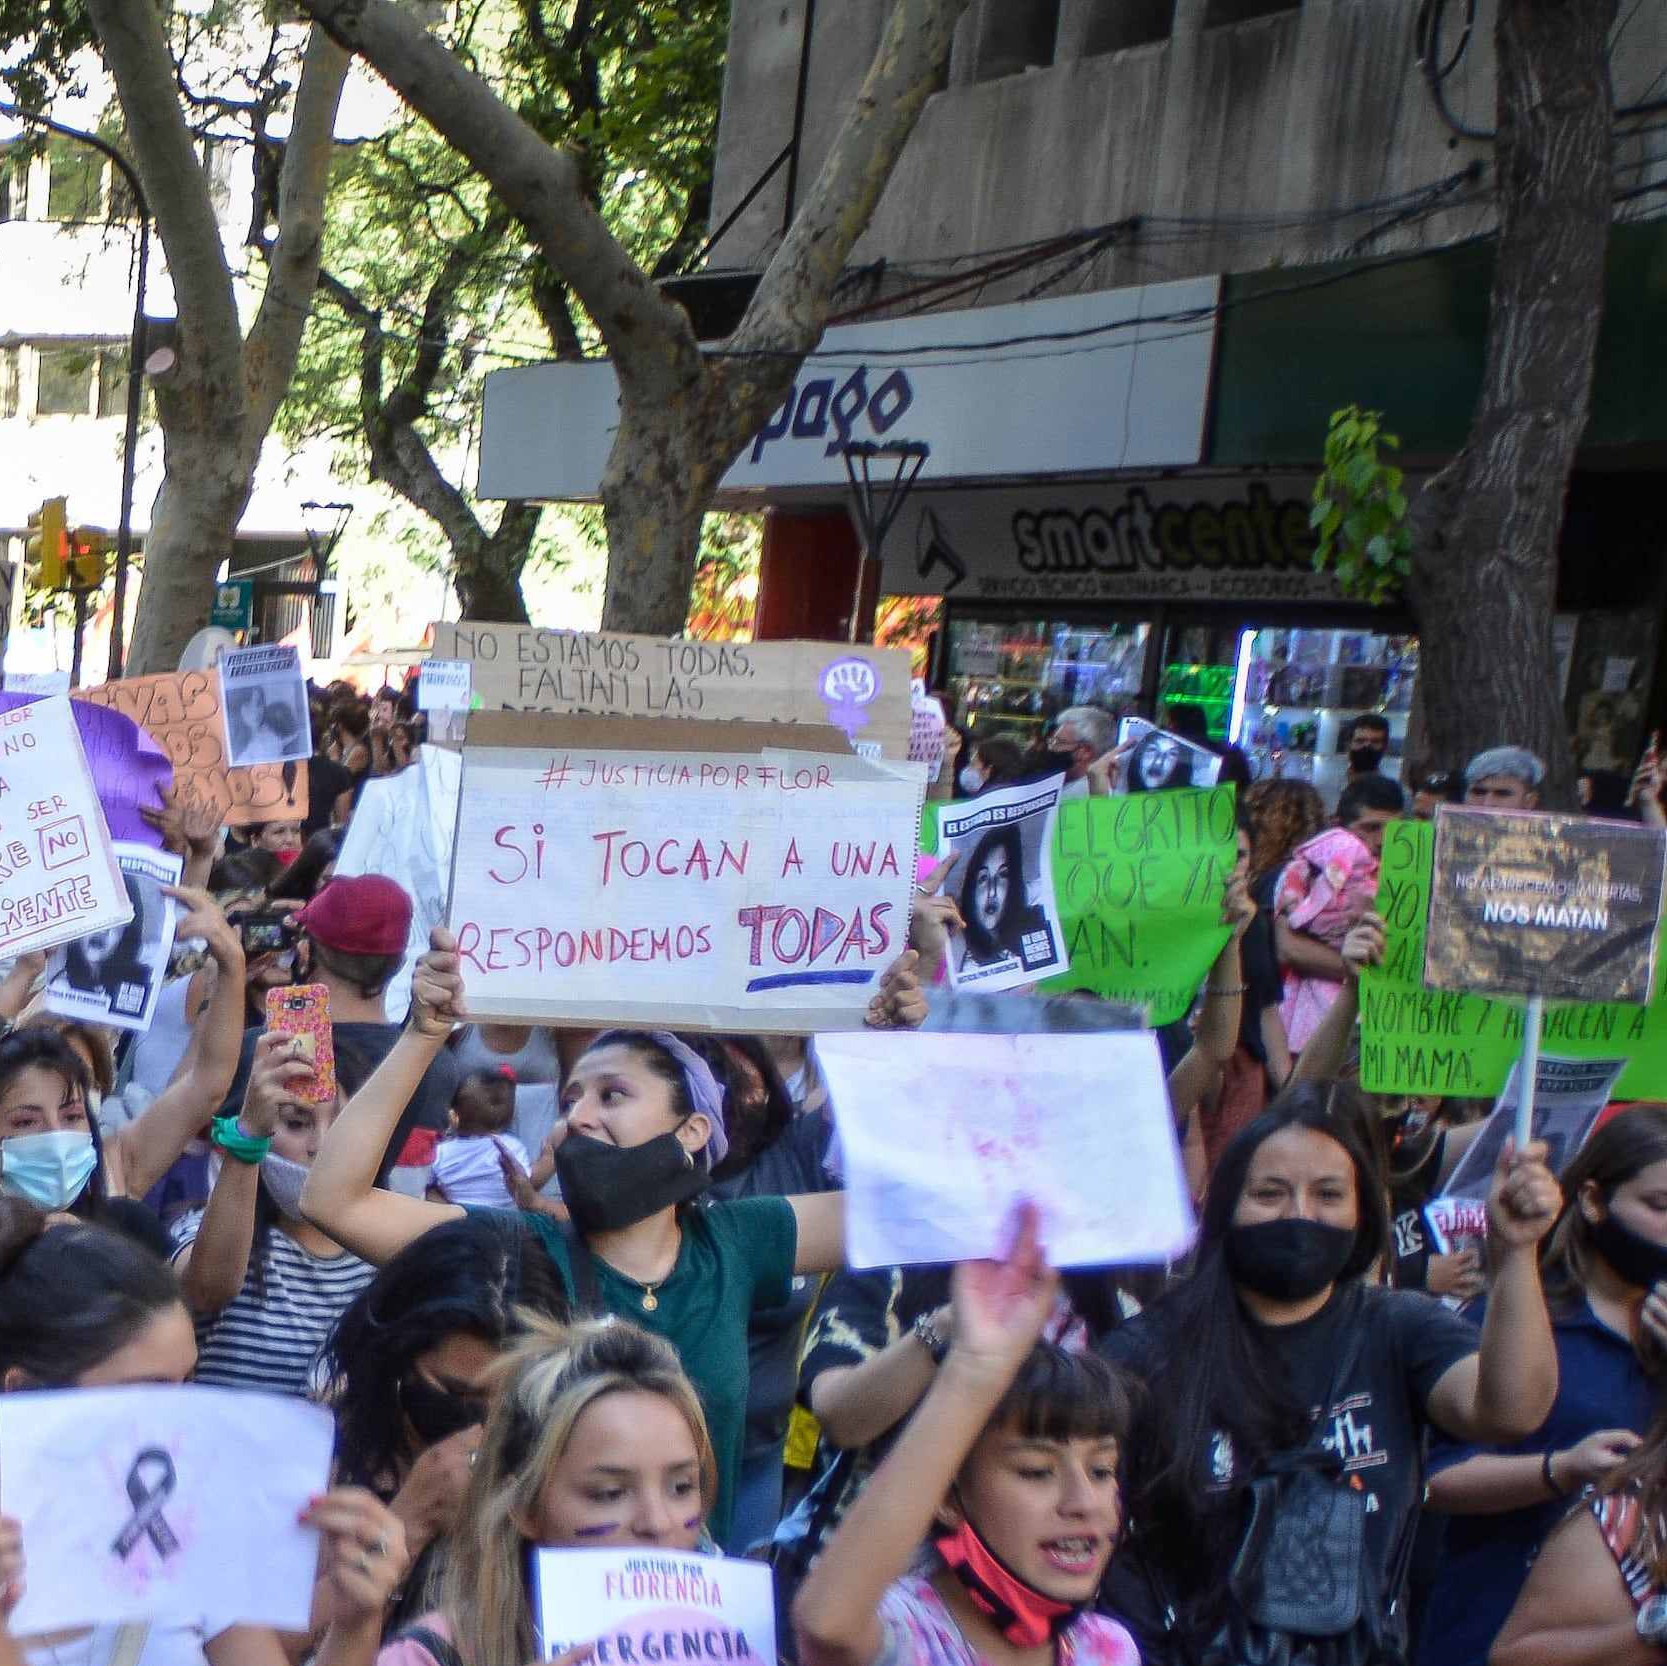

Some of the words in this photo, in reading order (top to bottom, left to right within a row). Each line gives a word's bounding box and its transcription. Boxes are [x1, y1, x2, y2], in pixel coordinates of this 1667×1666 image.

[456, 631, 498, 661] NO
[517, 632, 640, 671] ESTAMOS
[518, 667, 630, 709] FALTAN
[645, 677, 704, 711] LAS
[27, 795, 68, 821] SER
[947, 821, 960, 835] EL
[992, 805, 1006, 819] ES
[1115, 792, 1236, 855] GRITO
[48, 830, 79, 855] NO
[593, 829, 749, 888] TOCAN
[782, 837, 805, 879] A
[832, 839, 901, 878] UNA
[1067, 856, 1163, 912] QUE
[1455, 871, 1479, 891] NO
[1484, 901, 1530, 927] NOS
[1534, 907, 1609, 932] MATAN
[457, 921, 713, 975] RESPONDEMOS
[739, 902, 894, 967] TODAS
[681, 1561, 703, 1577] POR
[605, 1571, 724, 1608] FLORENCIA
